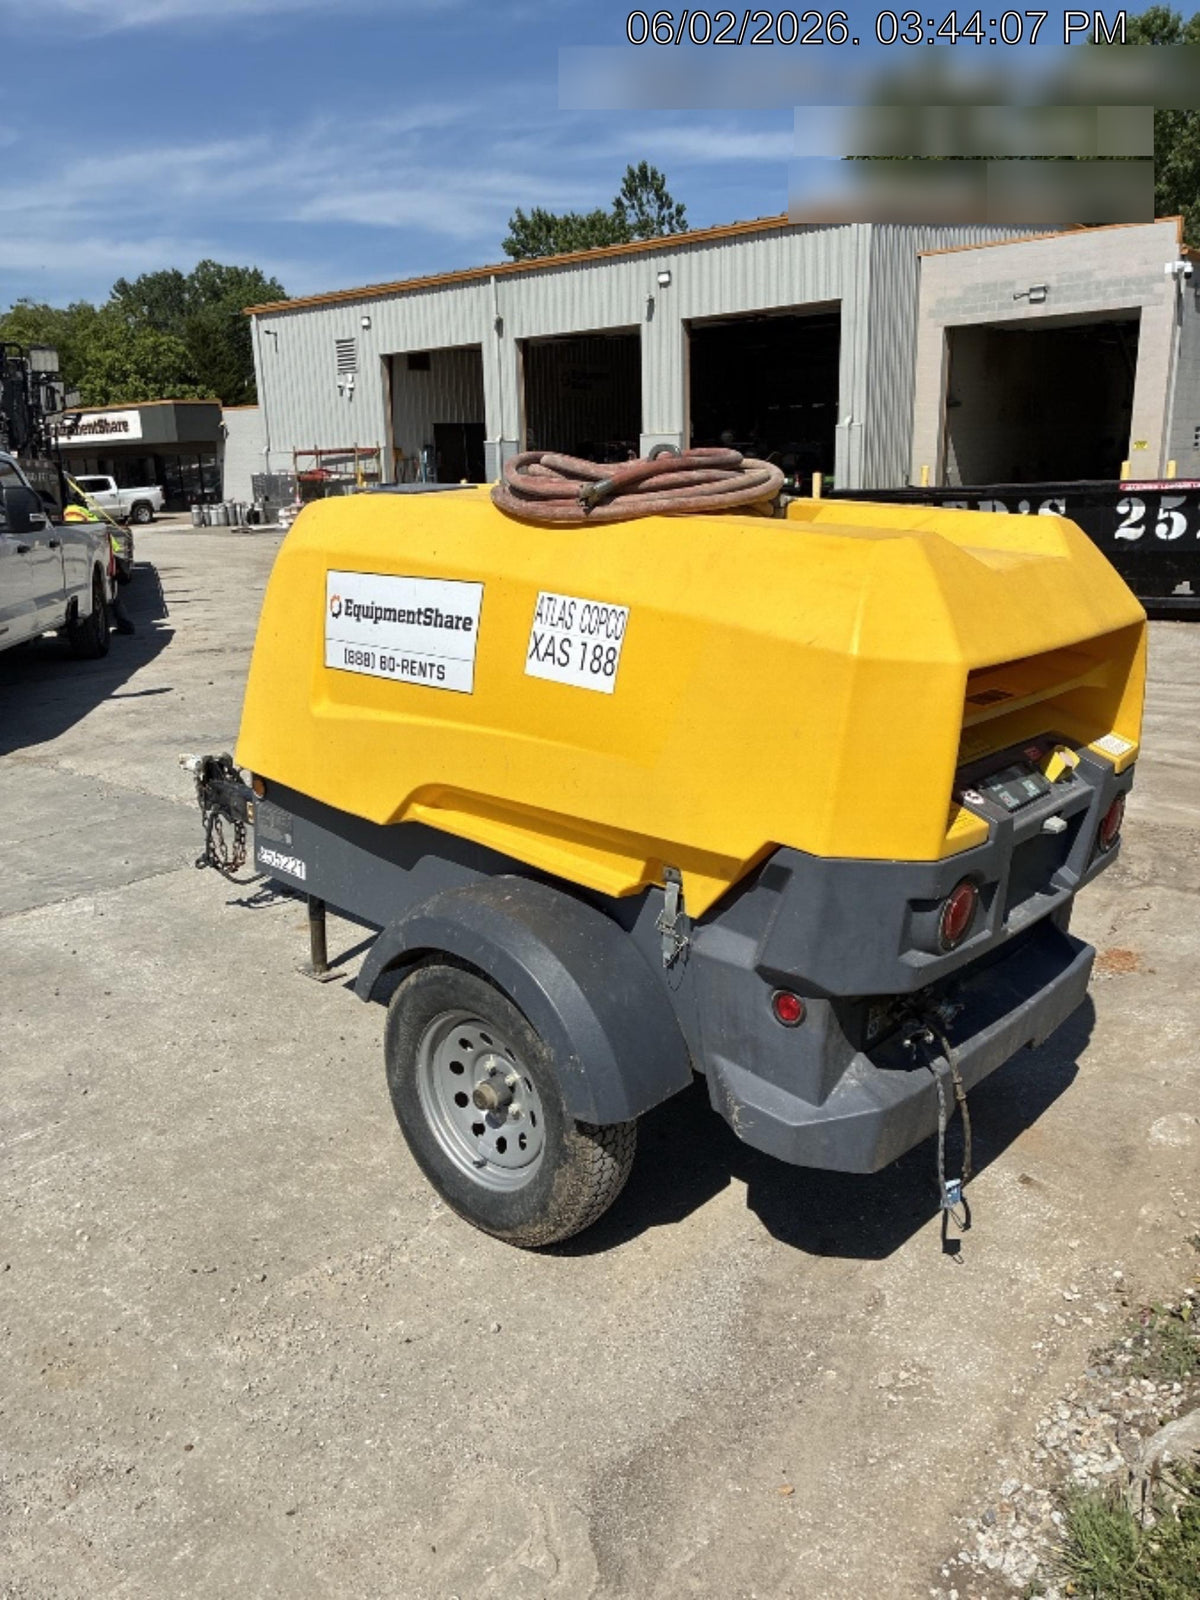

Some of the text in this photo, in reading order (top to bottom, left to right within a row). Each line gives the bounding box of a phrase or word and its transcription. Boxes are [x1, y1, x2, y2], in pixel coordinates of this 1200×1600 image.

[1114, 496, 1200, 541] 25
[344, 598, 474, 632] EquipmentShare
[535, 595, 626, 641] ATLAS COPCO
[344, 647, 376, 669] (888)
[529, 630, 618, 677] XAS 188
